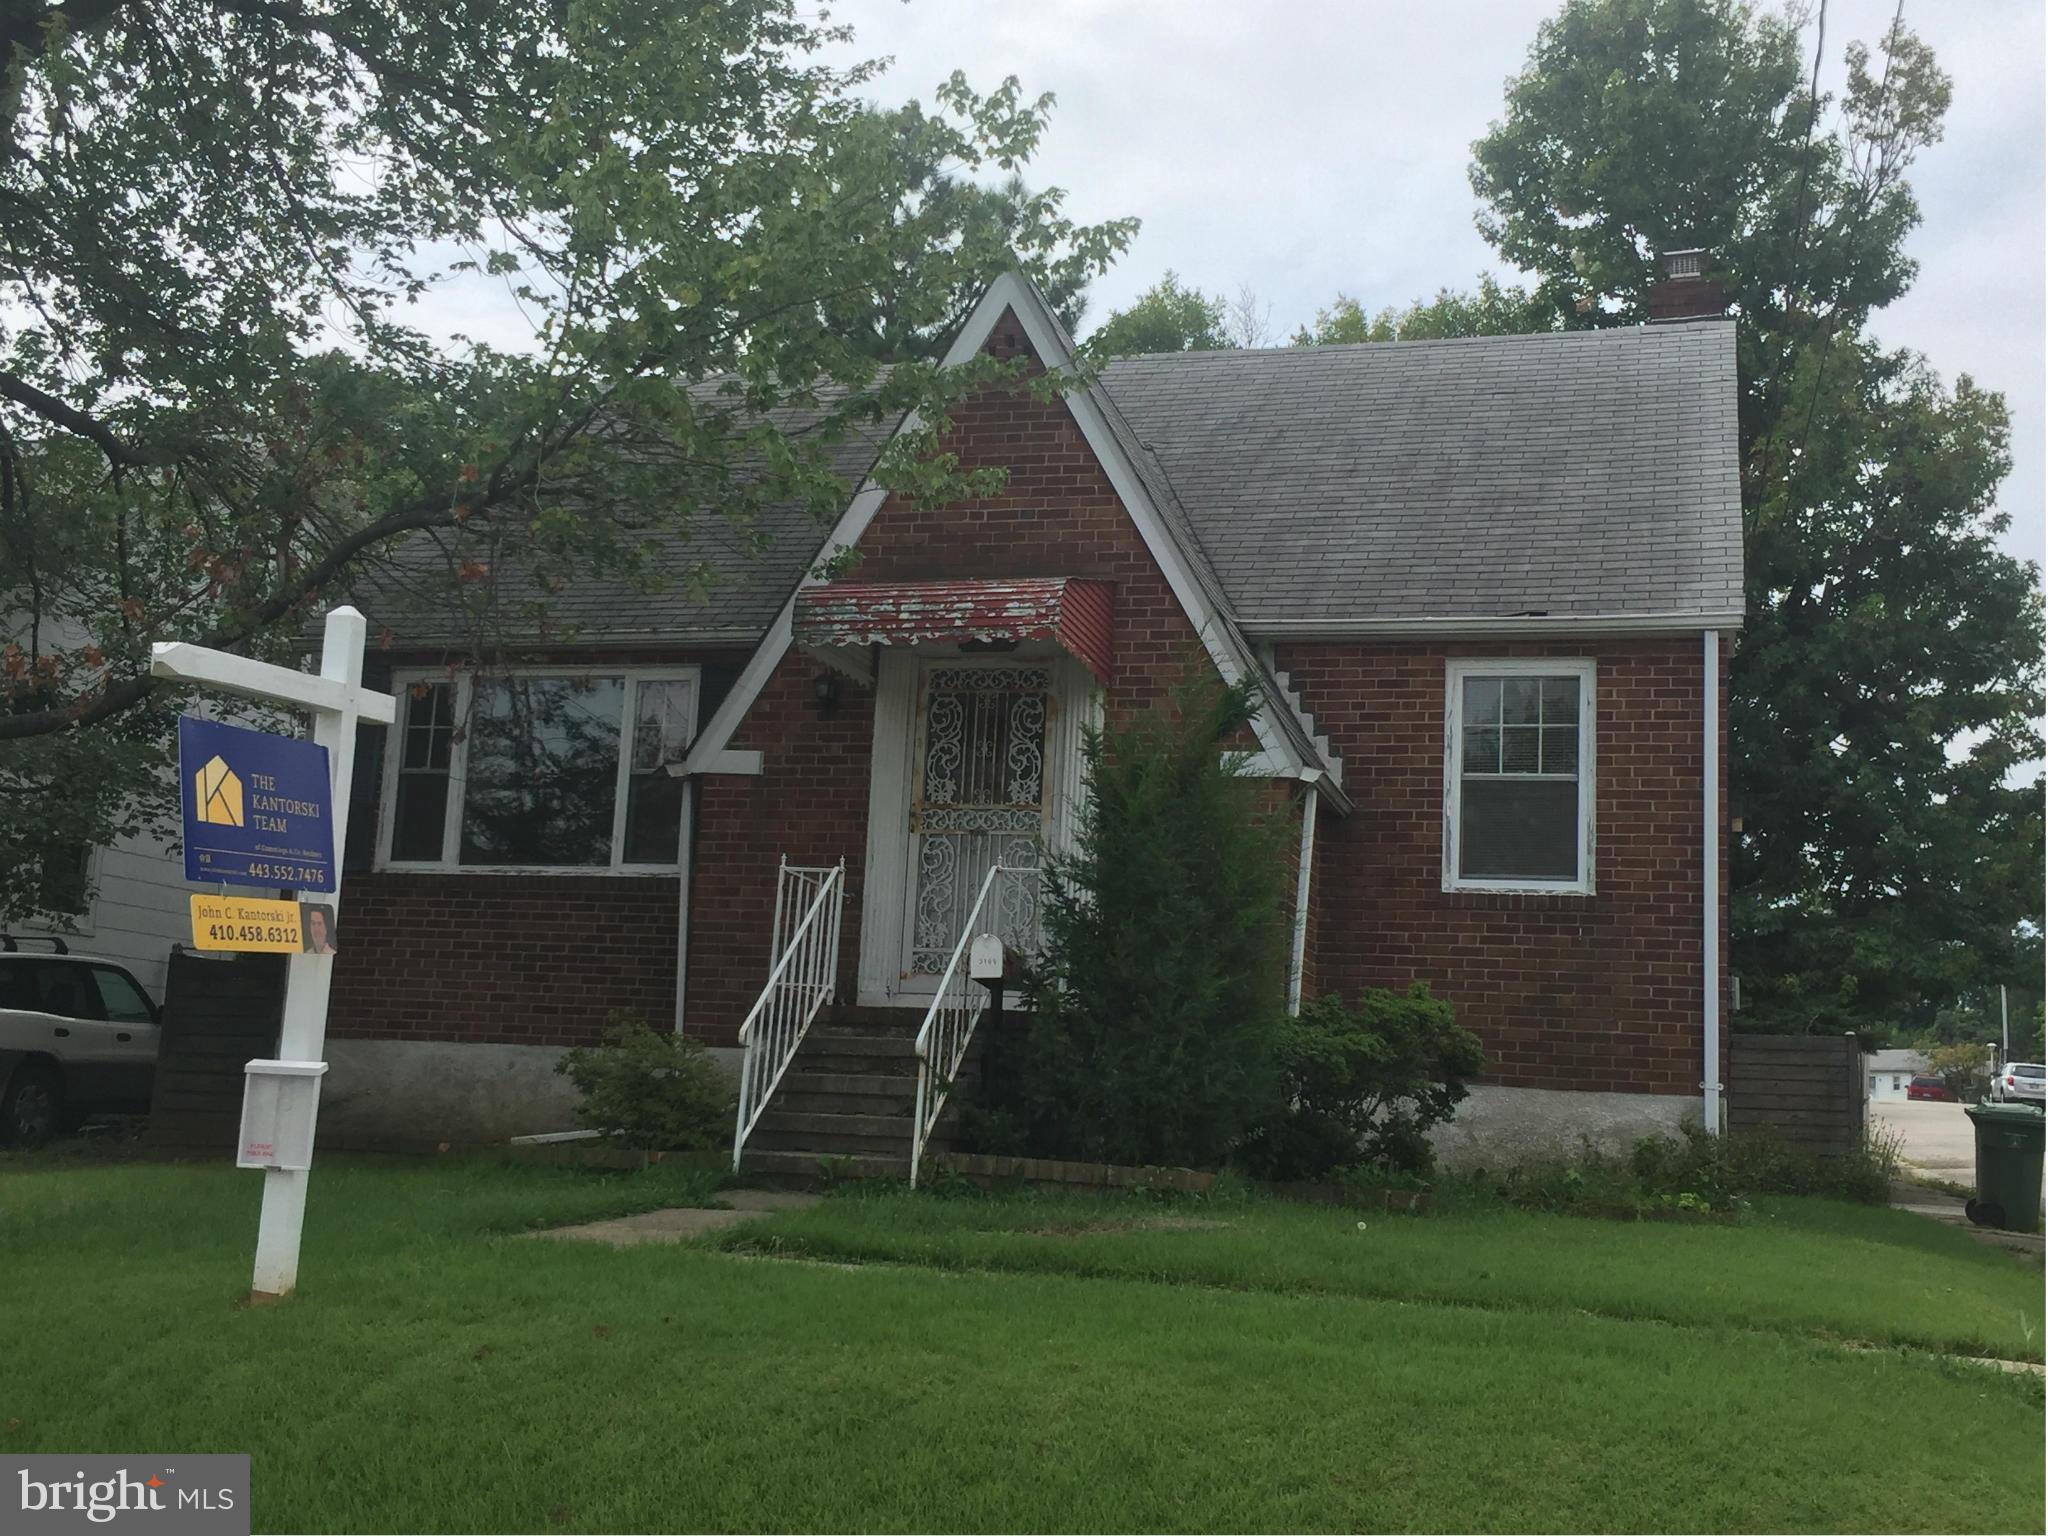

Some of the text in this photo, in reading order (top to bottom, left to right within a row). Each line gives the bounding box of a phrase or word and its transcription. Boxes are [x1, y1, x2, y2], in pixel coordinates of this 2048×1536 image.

[251, 773, 276, 791] THE
[252, 794, 320, 818] KANTORSKI
[252, 815, 288, 833] TEAM
[248, 863, 324, 884] 443.552.7476
[197, 905, 222, 920] John
[237, 907, 284, 922] Kantorski
[209, 924, 298, 944] 410.458.6312
